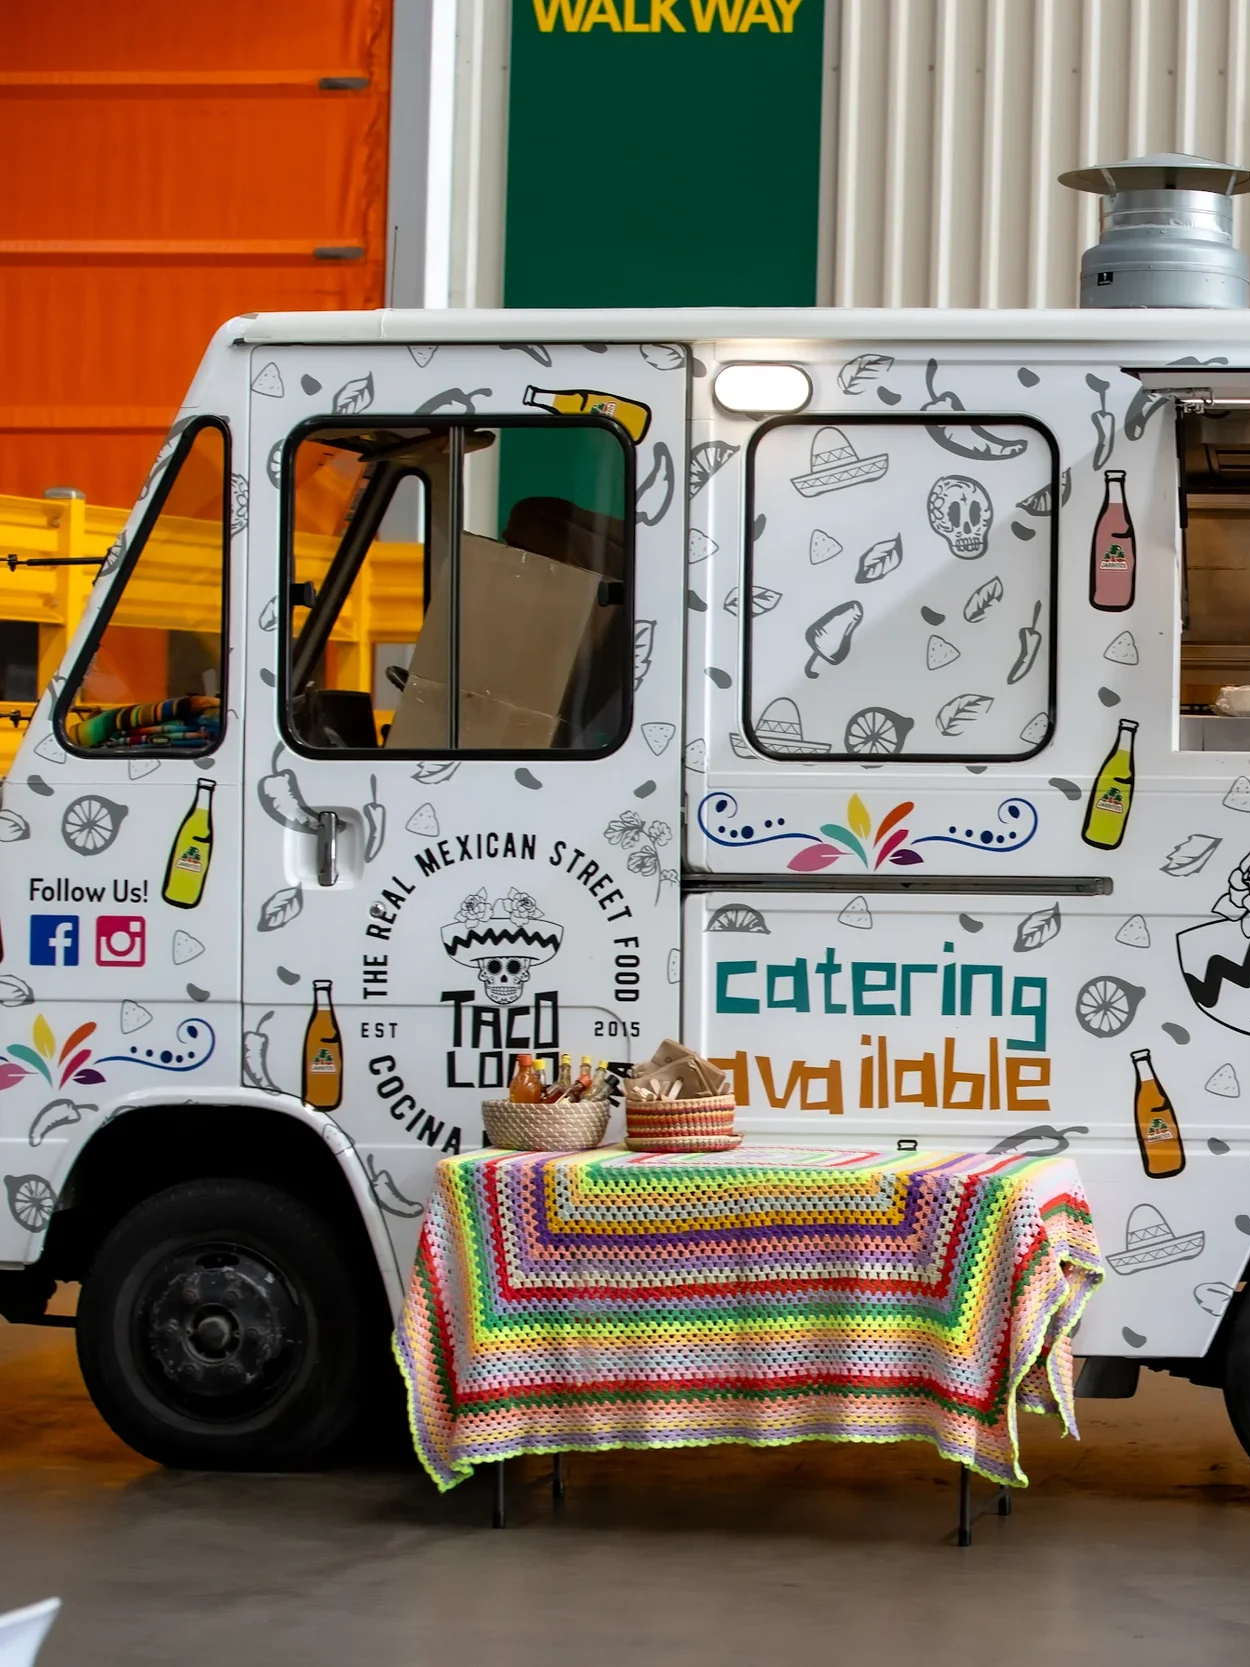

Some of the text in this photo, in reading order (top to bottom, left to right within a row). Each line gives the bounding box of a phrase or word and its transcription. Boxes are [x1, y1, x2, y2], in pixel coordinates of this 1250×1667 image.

[532, 0, 801, 33] WALKWAY
[29, 878, 148, 903] Follow Us!
[363, 832, 640, 1002] THE REAL MEXICAN STREET FOOD
[361, 1021, 640, 1038] EST 2015
[440, 990, 559, 1049] TACO
[716, 941, 1048, 1051] catering
[369, 1055, 461, 1155] COCINA
[707, 1034, 1051, 1114] available
